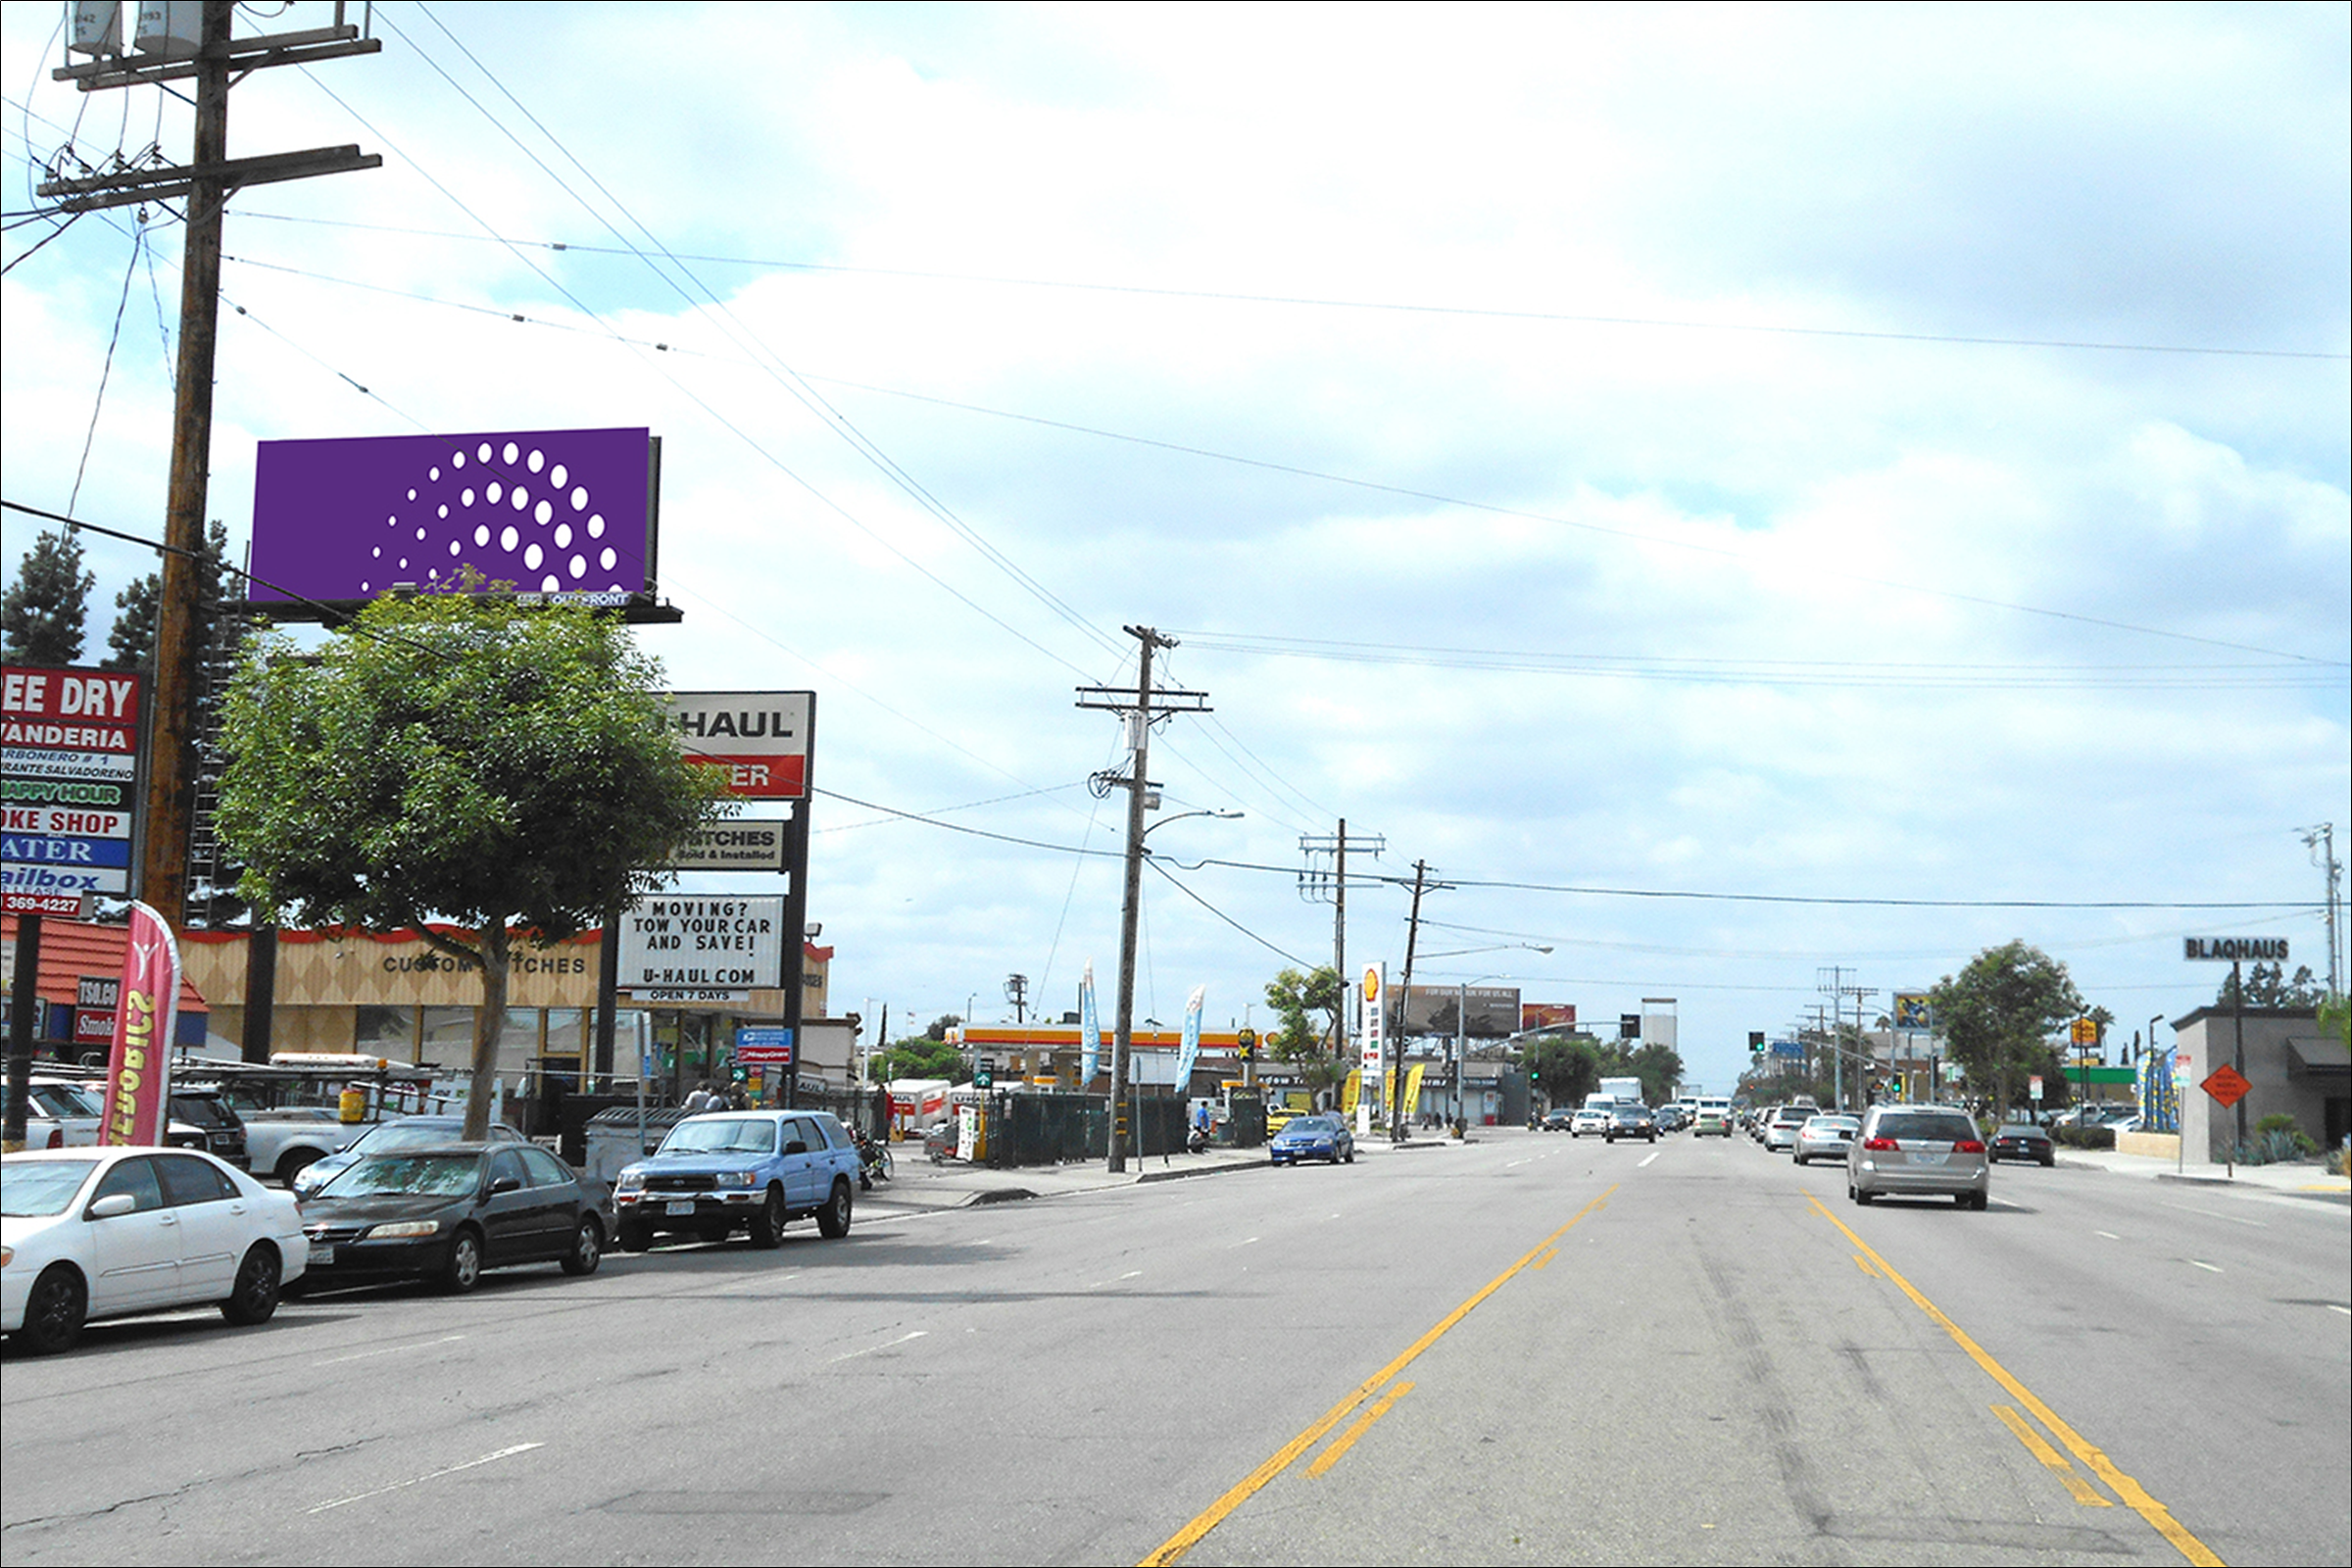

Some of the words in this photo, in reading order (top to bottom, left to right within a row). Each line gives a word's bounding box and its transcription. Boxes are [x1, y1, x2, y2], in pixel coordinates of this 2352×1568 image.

[551, 593, 629, 606] OUFRONT
[1, 674, 47, 712] EE
[60, 677, 133, 717] DRY
[670, 711, 793, 738] HAUL
[1, 763, 43, 774] RANTE
[58, 784, 121, 804] HOUR
[50, 812, 118, 834] SHOP
[702, 831, 775, 846] TCHES
[7, 897, 78, 912] 369-4227
[652, 903, 748, 916] MOVING?
[634, 919, 669, 932] TOW
[680, 919, 728, 933] YOUR
[734, 919, 770, 933] CAR
[647, 936, 681, 950] AND
[696, 936, 755, 956] SAVE!
[2186, 939, 2289, 959] BLAQHAUS
[512, 957, 584, 973] TCHES
[651, 990, 683, 1000] OPEN
[688, 991, 695, 1000] 7
[699, 991, 730, 1001] DAYS
